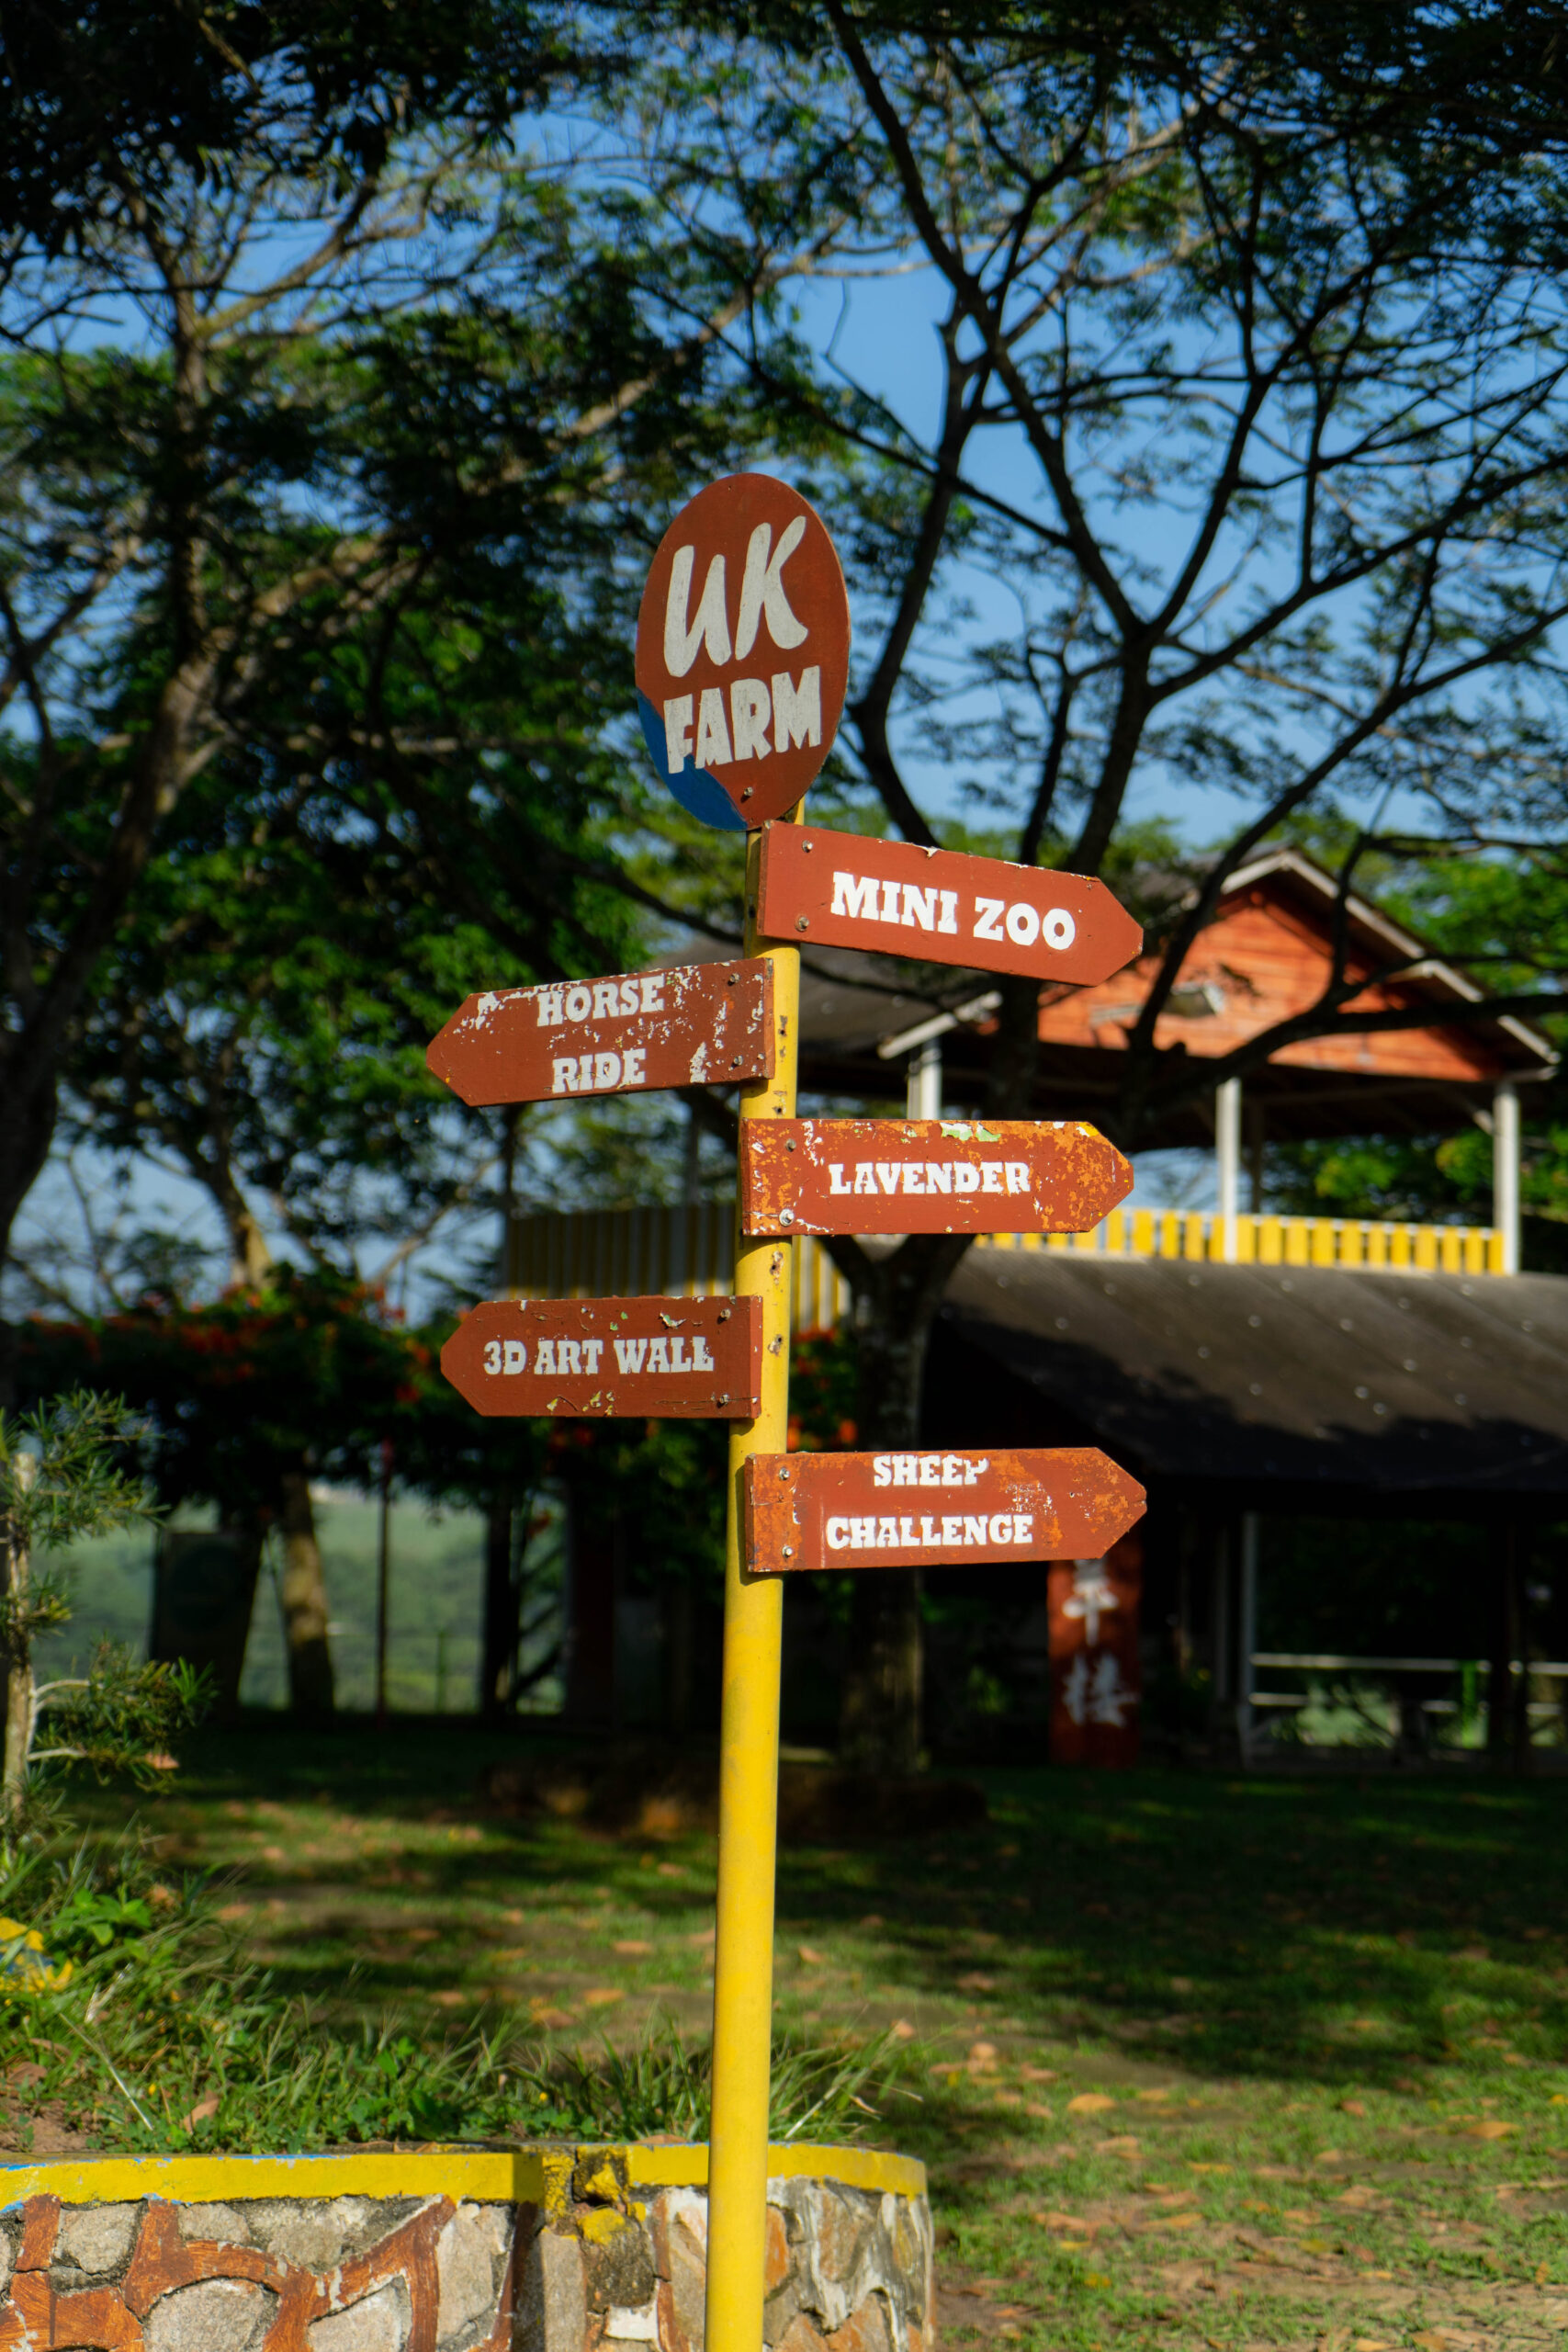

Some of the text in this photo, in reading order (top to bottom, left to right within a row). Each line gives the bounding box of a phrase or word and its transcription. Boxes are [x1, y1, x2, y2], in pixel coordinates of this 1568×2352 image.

[664, 515, 807, 677] UK
[663, 665, 820, 774] FARM
[830, 871, 1076, 950] MINI ZOO
[537, 974, 665, 1028] HORSE
[552, 1048, 646, 1094] RIDE
[829, 1161, 1031, 1195] LAVENDER
[483, 1336, 714, 1375] 3D ART WALL
[874, 1454, 988, 1487] SHEEP
[826, 1515, 1033, 1549] CHALLENGE
